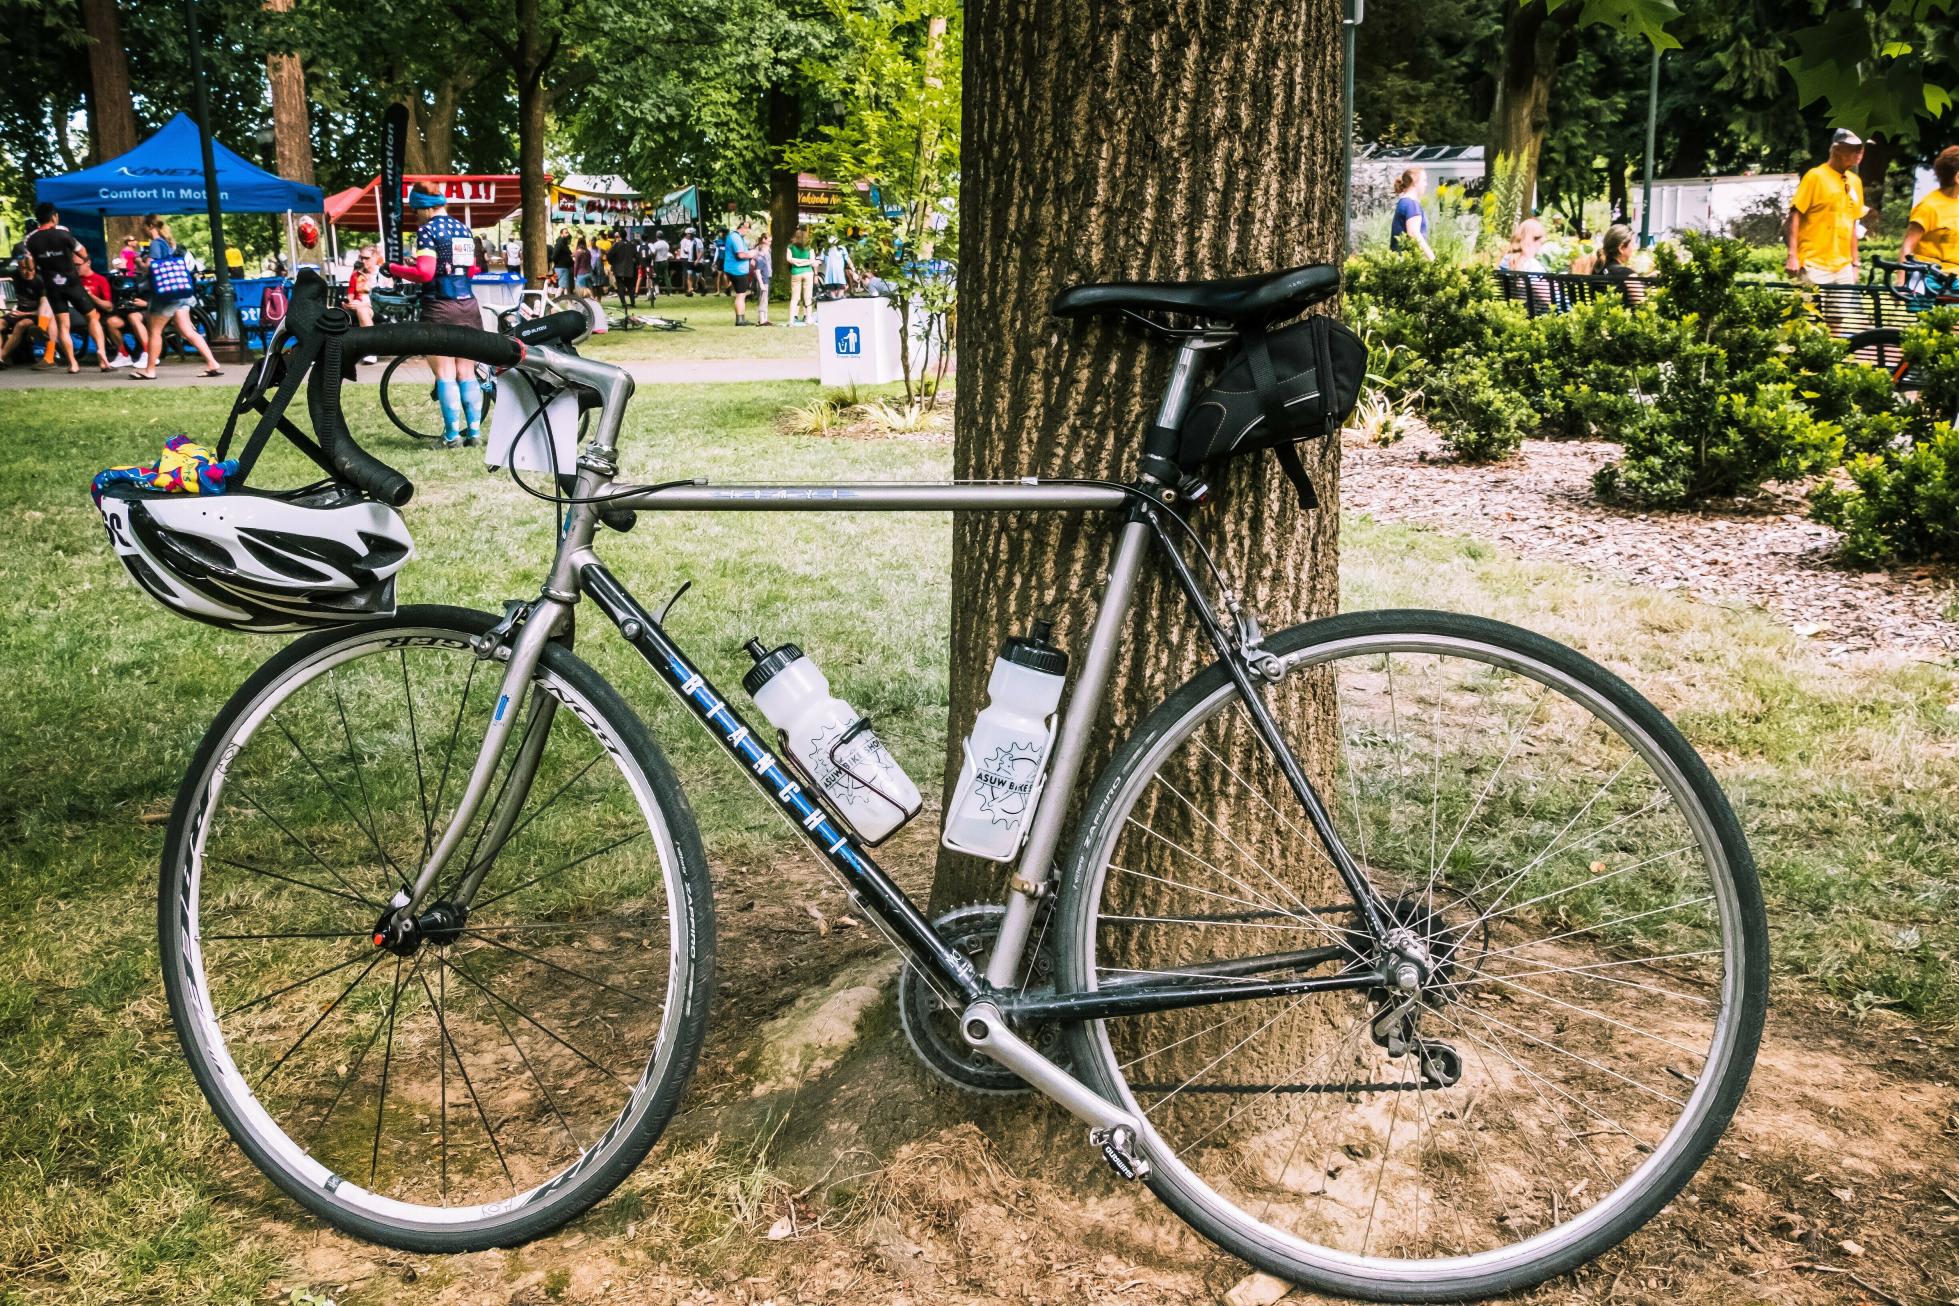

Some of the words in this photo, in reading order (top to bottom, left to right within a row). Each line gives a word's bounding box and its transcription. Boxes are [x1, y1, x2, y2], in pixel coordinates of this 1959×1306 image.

[99, 187, 158, 199] Comfort
[161, 187, 176, 199] In
[179, 188, 230, 200] Motn
[681, 673, 848, 855] BIANCHI
[976, 772, 1007, 788] ASUW
[1083, 775, 1122, 849] ZAFFIRO
[685, 881, 697, 960] ZAFFIRO
[1105, 1146, 1134, 1179] SHIMANO
